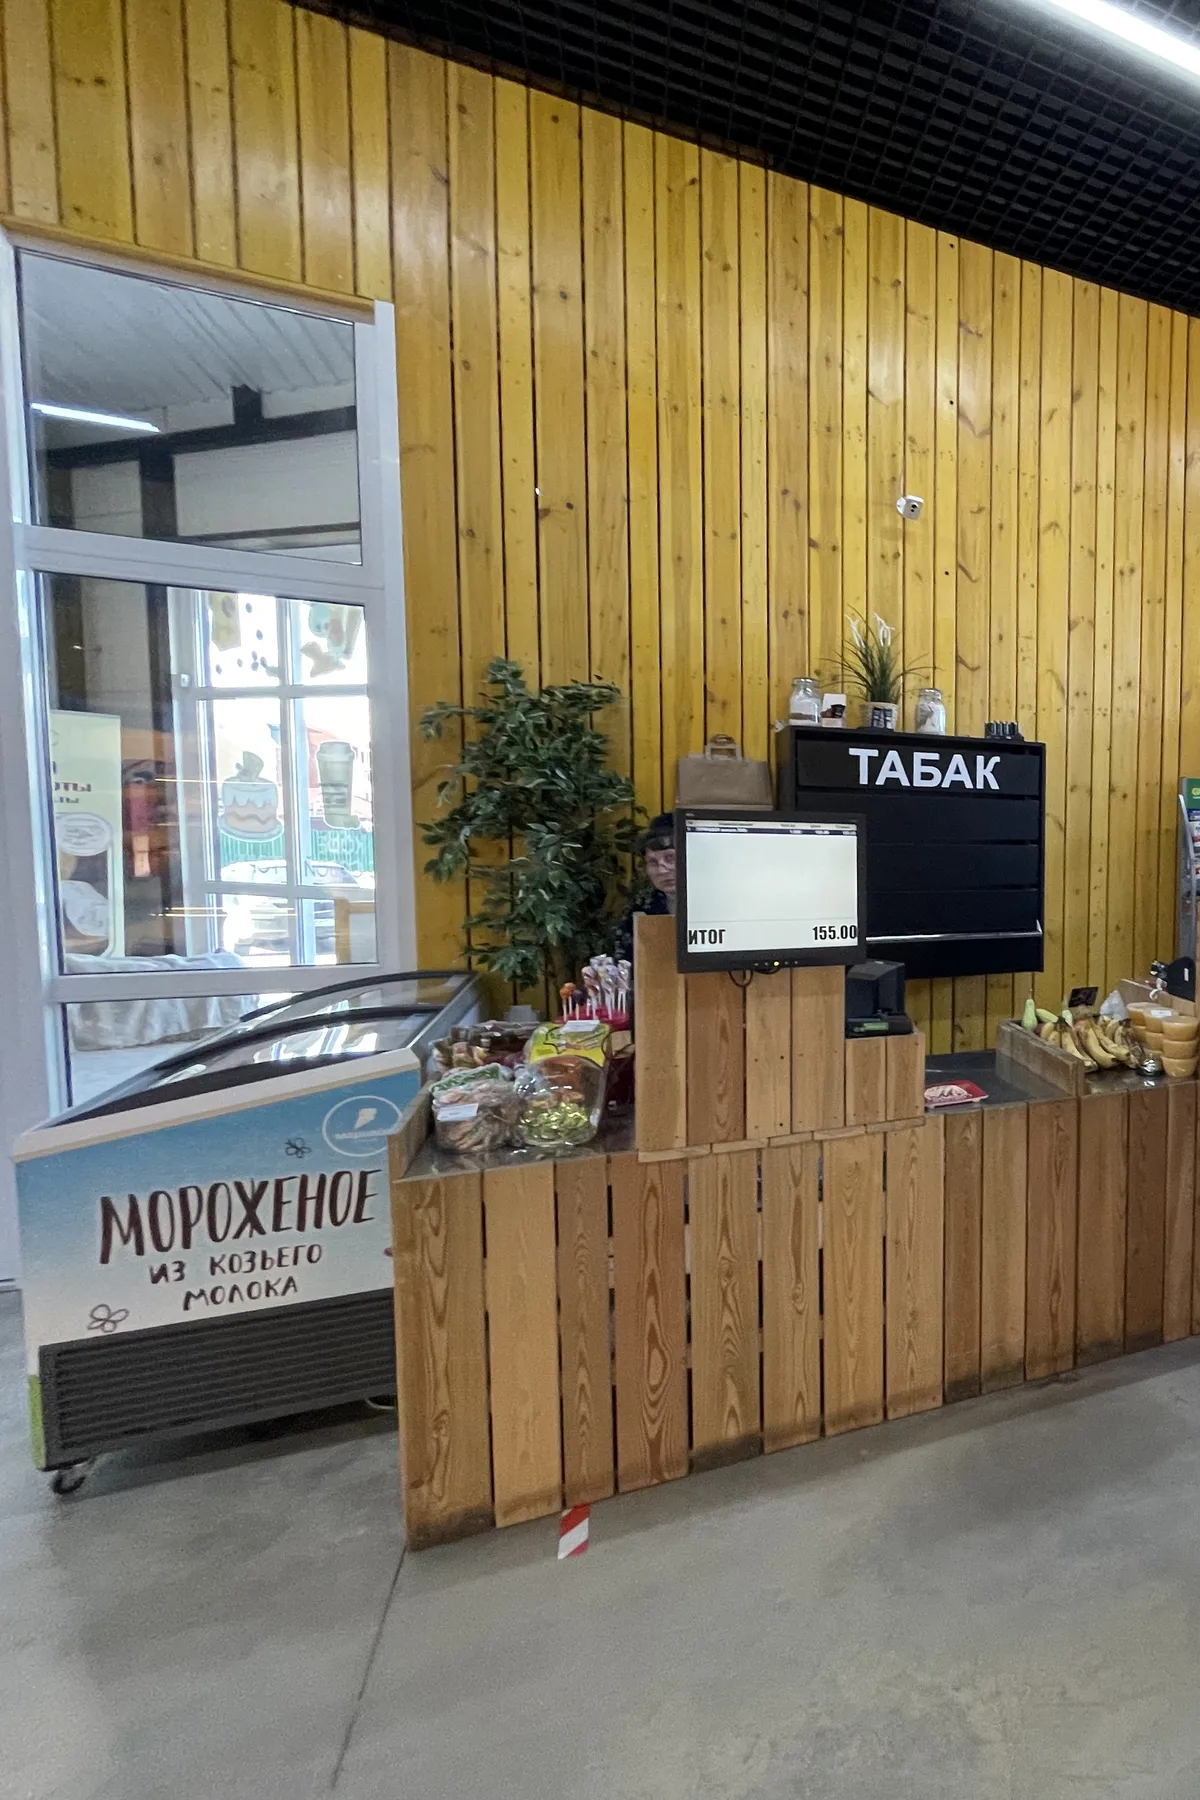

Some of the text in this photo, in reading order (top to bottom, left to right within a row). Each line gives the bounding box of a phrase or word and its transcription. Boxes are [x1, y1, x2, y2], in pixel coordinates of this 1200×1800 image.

[849, 748, 1001, 790] ТАБАК
[688, 924, 857, 945] ИТОГ 155.00
[100, 1169, 382, 1264] МОРОЖЕНОЕ
[150, 1243, 323, 1284] ИЗ КОЗЬЕГО
[183, 1276, 298, 1311] МОЛОКА
